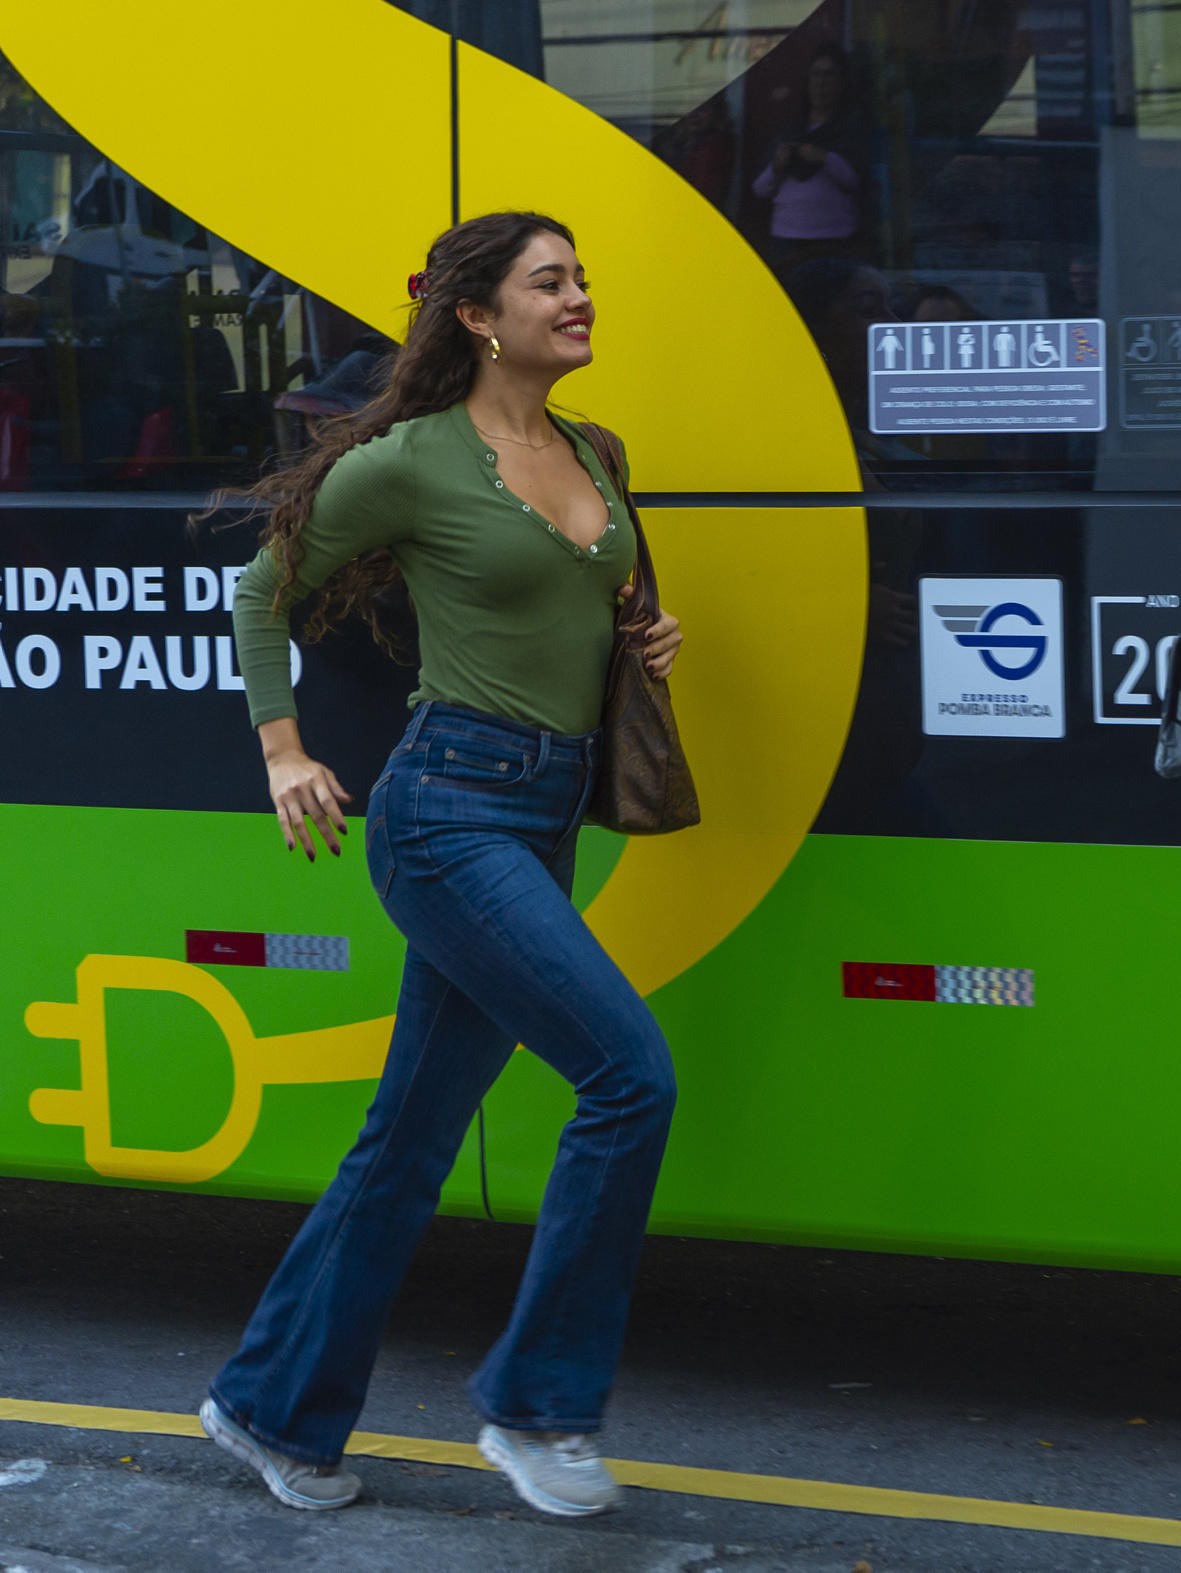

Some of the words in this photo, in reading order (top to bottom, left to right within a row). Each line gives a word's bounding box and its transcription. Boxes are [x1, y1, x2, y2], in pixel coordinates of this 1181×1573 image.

[0, 566, 166, 611] IDADE
[1146, 595, 1180, 608] ANO
[83, 633, 303, 690] PAUL
[938, 702, 991, 716] POMBA
[993, 704, 1053, 717] BRANCA
